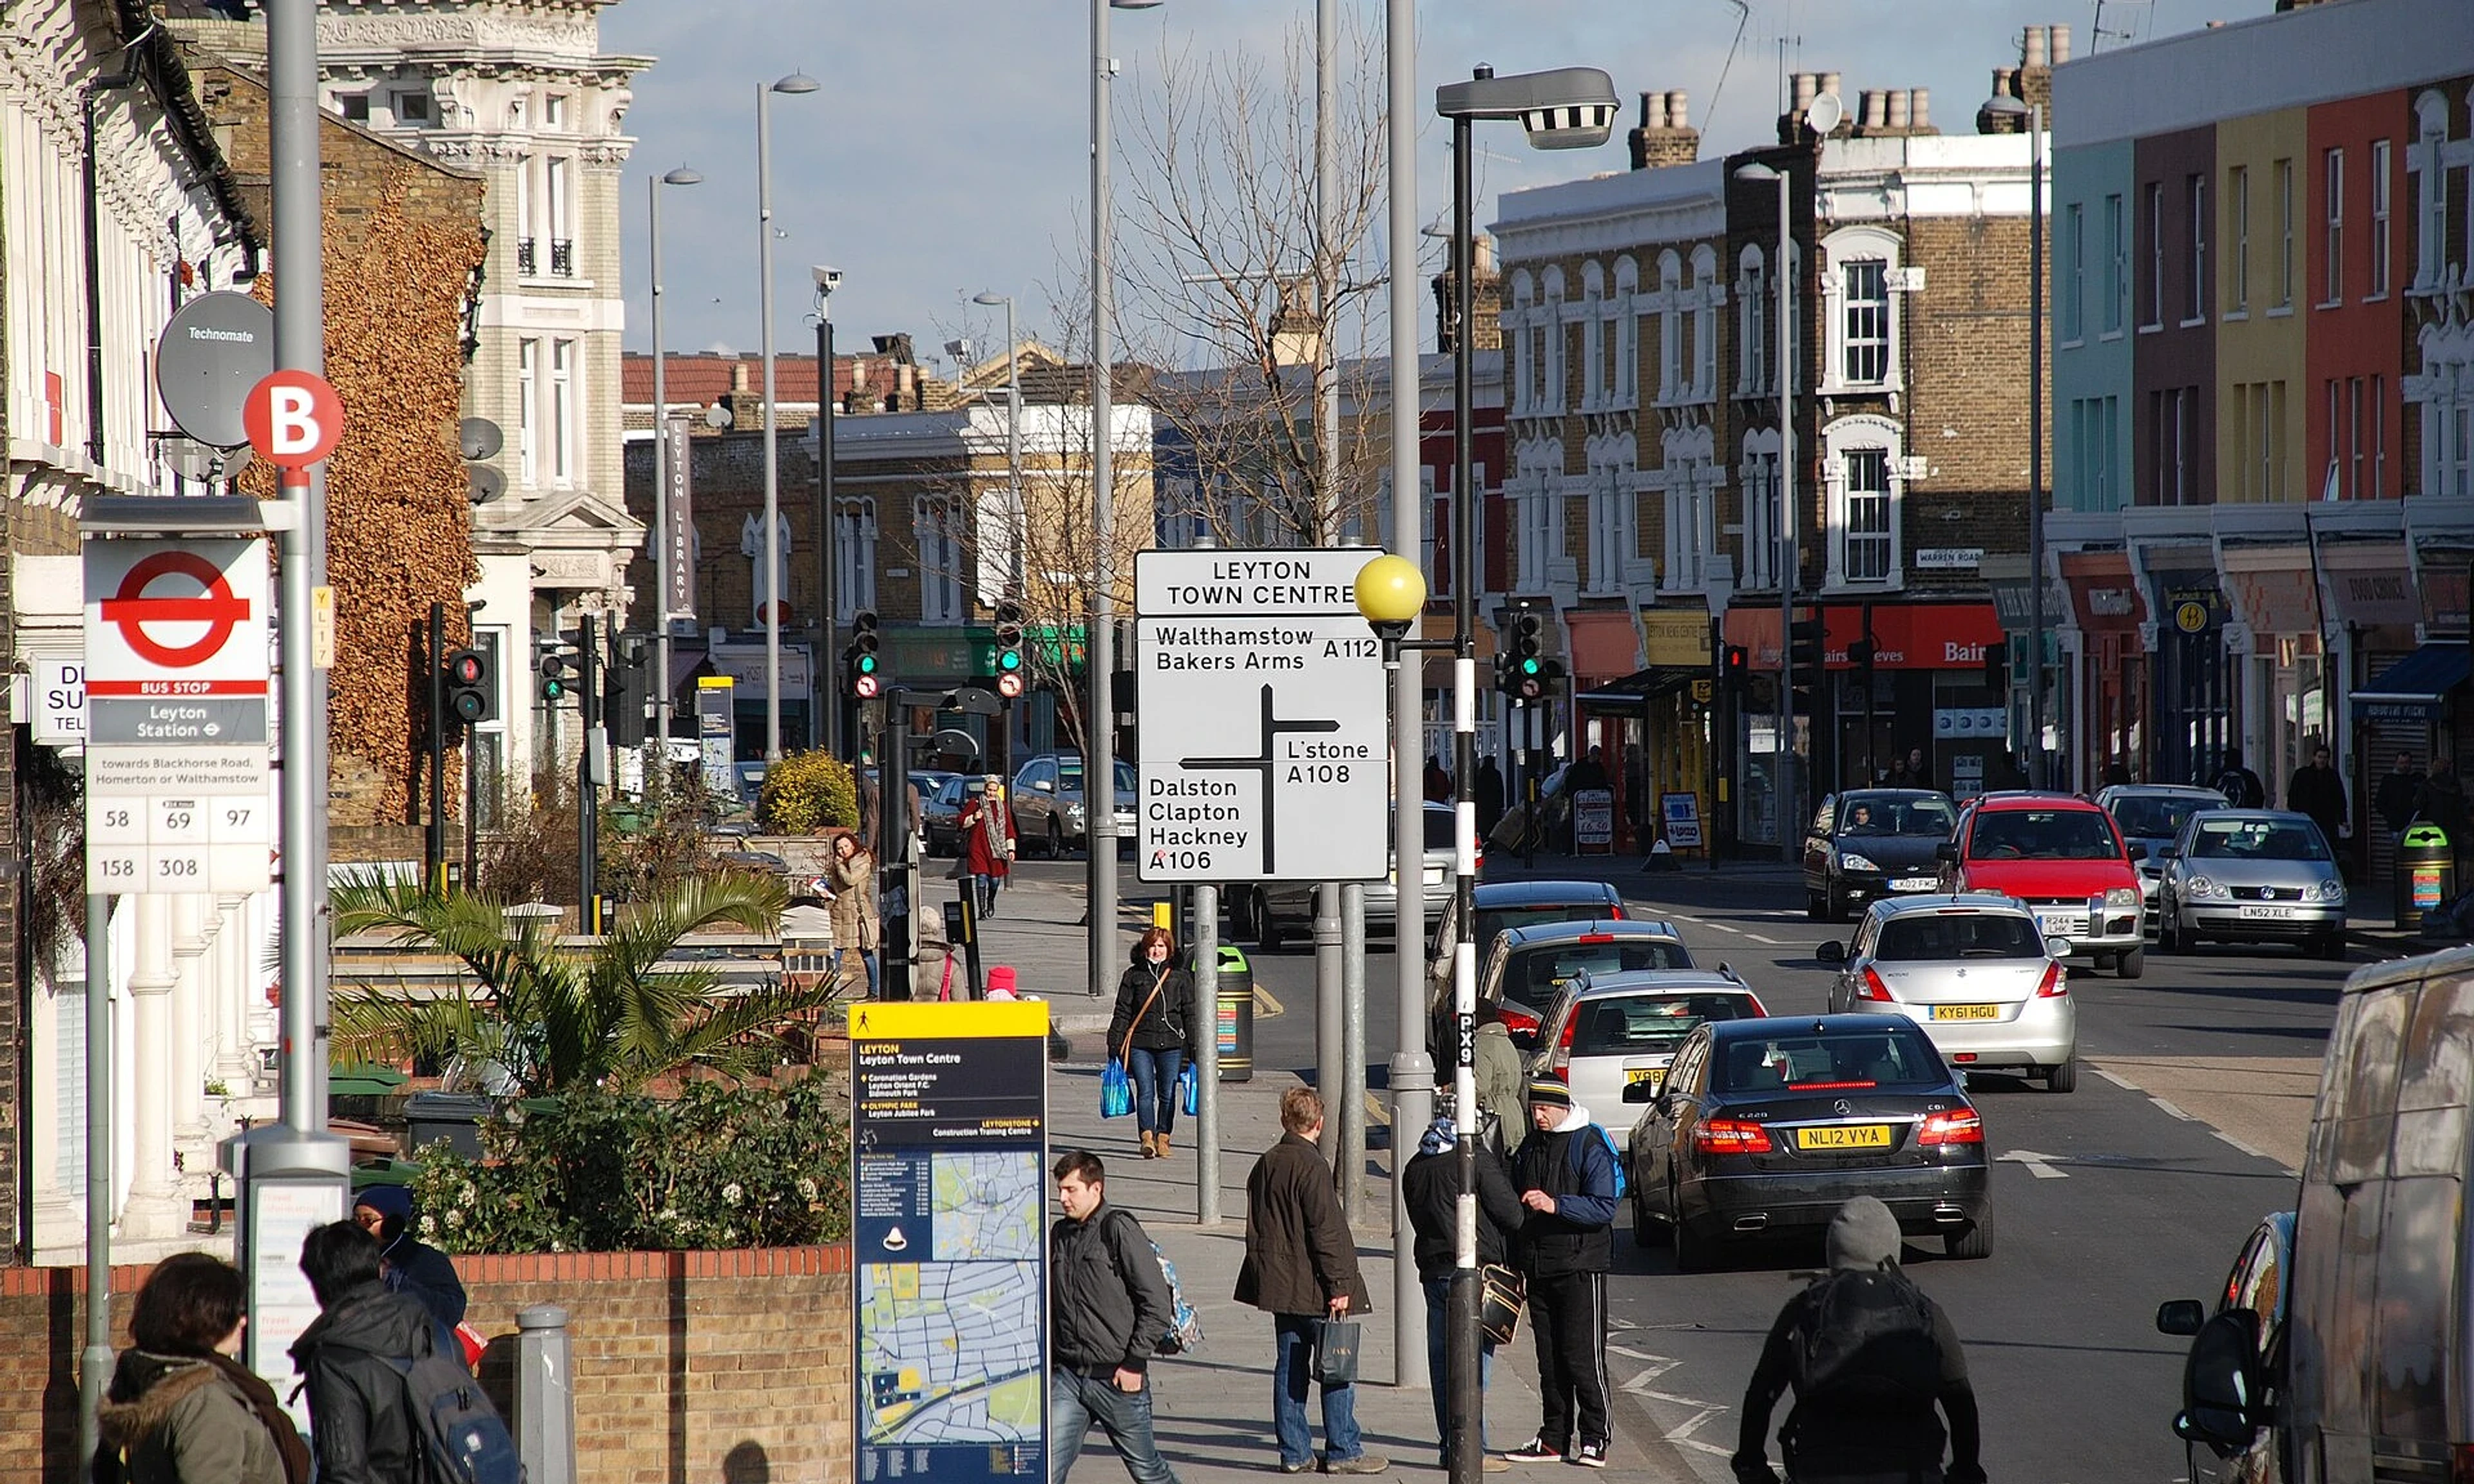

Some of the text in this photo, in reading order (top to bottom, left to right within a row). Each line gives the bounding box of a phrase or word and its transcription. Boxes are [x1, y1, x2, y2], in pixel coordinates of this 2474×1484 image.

[189, 327, 253, 343] Technomate
[269, 386, 321, 455] B
[673, 421, 684, 498] LEYTON
[675, 511, 686, 600] LIBRARY
[1920, 553, 1980, 562] WARREN ROAD
[1213, 561, 1311, 580] LEYTON
[1167, 585, 1355, 605] TOWN CENTRE
[1998, 588, 2020, 616] THE
[1156, 627, 1313, 646] Walthamstow
[1323, 640, 1377, 658] A112
[1156, 652, 1305, 671] Bakers Arms
[141, 682, 211, 694] BUS STOP
[150, 706, 207, 721] Leyton
[137, 722, 197, 737] Station
[1288, 740, 1369, 759] L'stone
[102, 759, 149, 769] towards
[153, 758, 218, 768] Blackhorse
[96, 773, 259, 785] Homerton or Walthamstow
[1287, 766, 1350, 784] A108
[1150, 778, 1237, 796] Dalston
[105, 810, 251, 830] 58 69 97
[1149, 803, 1240, 823] Clapton
[1150, 828, 1249, 848] Hackney
[102, 859, 198, 877] 158 308
[1150, 851, 1211, 870] A106
[2046, 916, 2070, 924] R244
[2244, 907, 2292, 918] LN52 XLE
[1939, 1006, 1995, 1018] KY61 HGU
[1459, 1016, 1472, 1063] PX9
[859, 1045, 899, 1054] LEYTON
[859, 1053, 961, 1066] Leyton Town Centre
[908, 1073, 937, 1081] Gardens
[868, 1082, 893, 1090] Leyton
[868, 1110, 893, 1118] Leyton
[933, 1127, 1032, 1137] Construction Training Centre
[981, 1119, 1031, 1128] LEYTONSTONE
[1808, 1128, 1879, 1145] NL12 VYA
